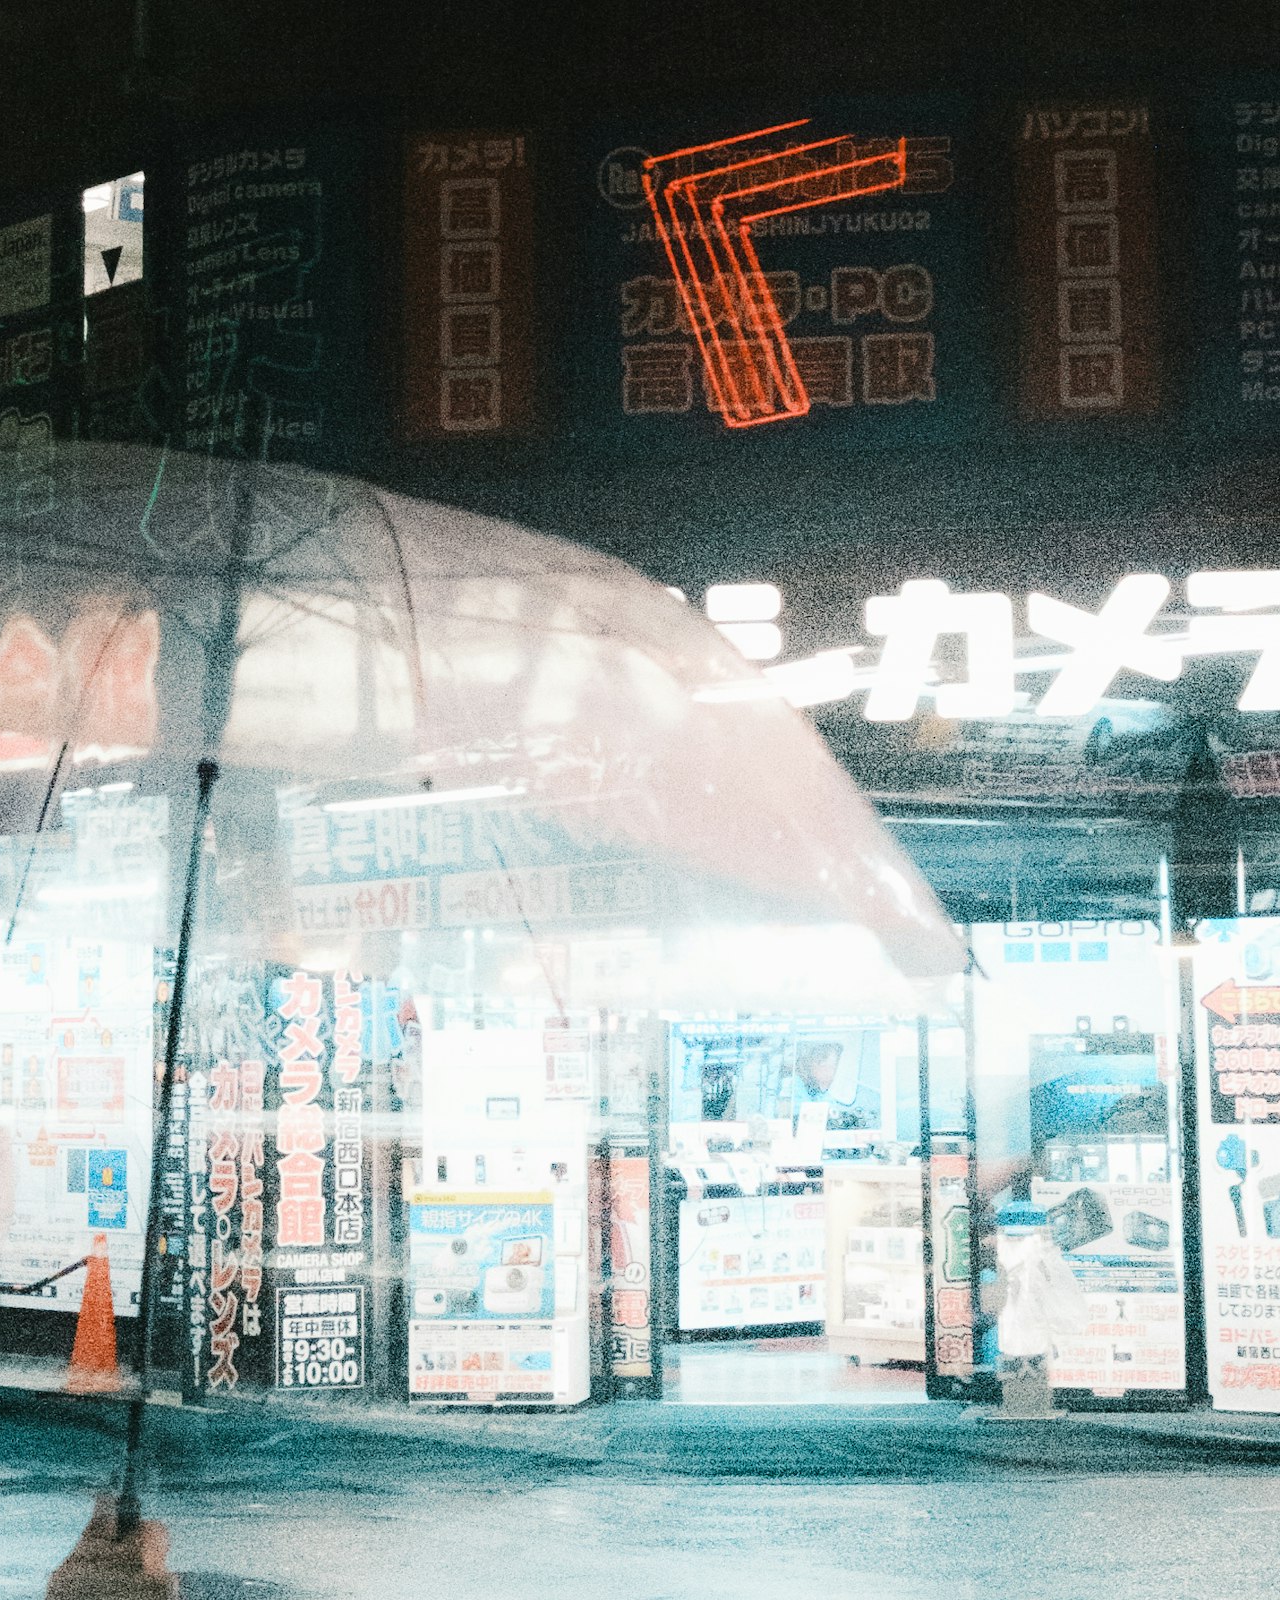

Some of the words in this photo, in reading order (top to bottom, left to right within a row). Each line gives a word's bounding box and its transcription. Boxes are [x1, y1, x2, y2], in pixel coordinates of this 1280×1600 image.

[1239, 319, 1277, 342] PC
[1002, 920, 1146, 938] GoPro
[277, 970, 324, 1247] カメラ総合館
[334, 1087, 363, 1246] 新宿西口本店
[1109, 1186, 1158, 1197] HERO
[420, 1208, 544, 1229] 親指サイズの4K
[277, 1253, 329, 1268] CAMERA
[330, 1252, 364, 1268] SHOP
[288, 1316, 354, 1339] 年中無休
[295, 1361, 359, 1387] 10:00
[414, 1374, 500, 1391] 好評販売中!!
